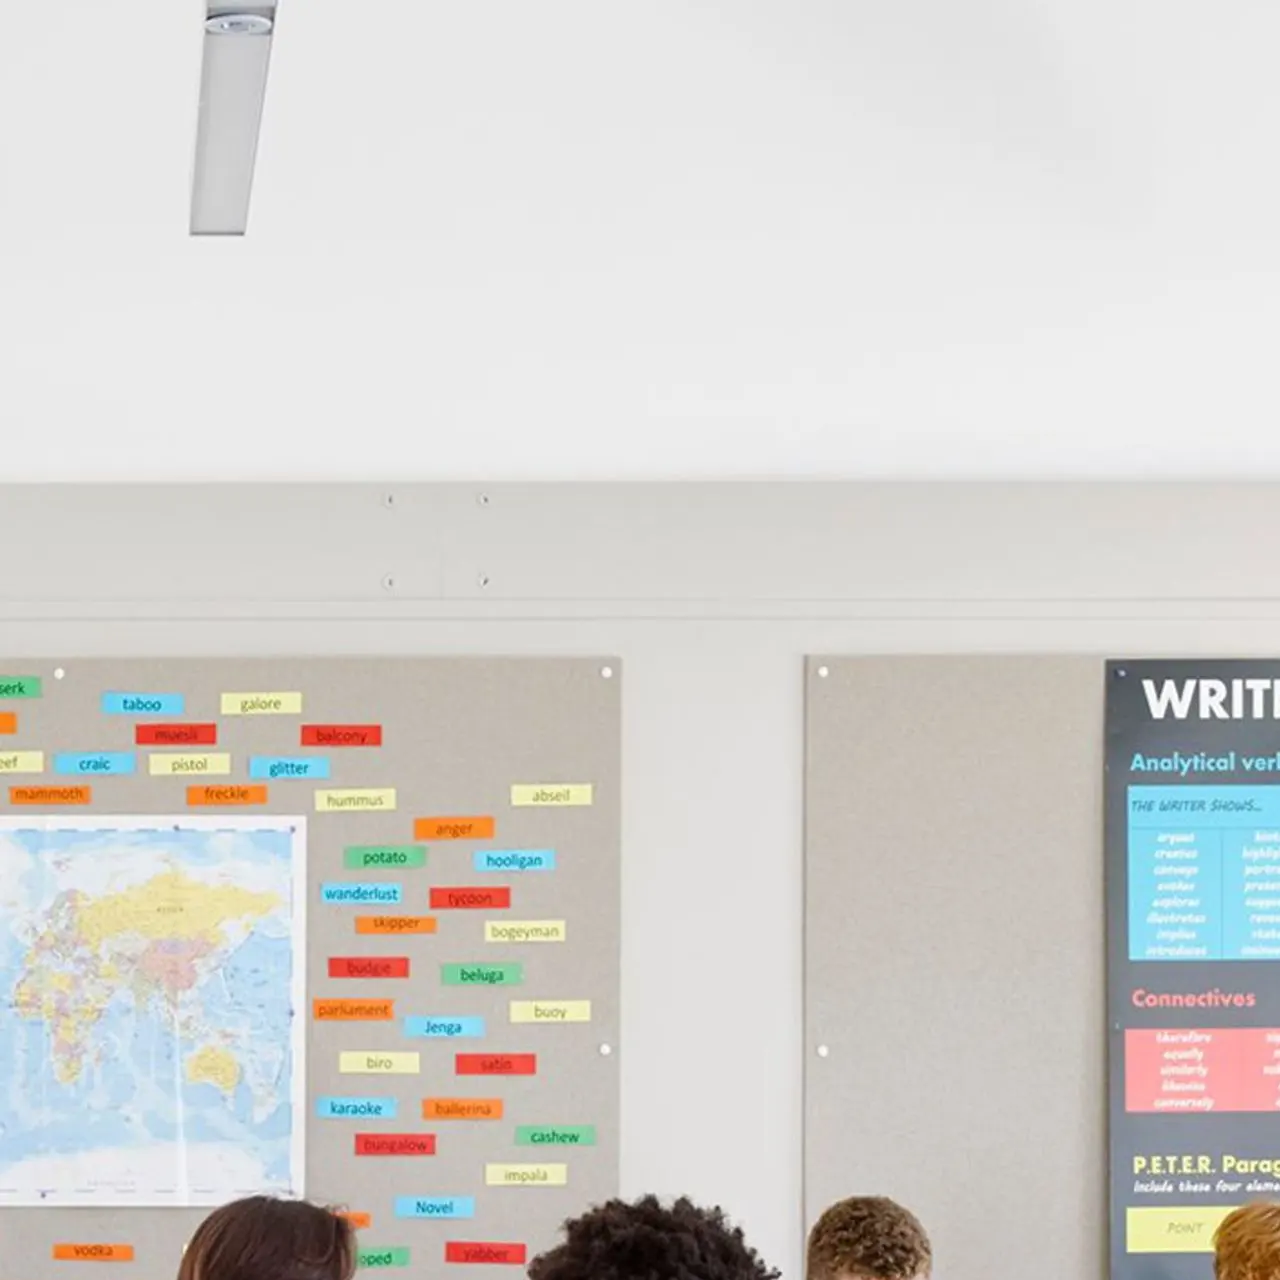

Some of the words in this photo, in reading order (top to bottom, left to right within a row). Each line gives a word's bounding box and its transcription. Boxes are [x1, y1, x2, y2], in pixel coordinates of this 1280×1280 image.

[122, 696, 162, 712] taboo
[240, 696, 281, 713] galore
[316, 728, 368, 745] balcony
[80, 756, 110, 772] craic
[171, 756, 208, 773] pistol
[269, 760, 309, 776] glitter
[1130, 754, 1235, 776] Analytical
[16, 786, 83, 800] mammoth
[205, 786, 248, 800] freckle
[327, 792, 384, 808] hummus
[532, 786, 570, 802] abseil
[1132, 800, 1156, 812] THE
[1159, 800, 1207, 812] WRITER
[436, 821, 473, 837] anger
[363, 849, 407, 867] potato
[486, 852, 543, 870] hooligan
[325, 886, 398, 902] wanderlust
[448, 890, 492, 907] tycoon
[374, 916, 420, 931] skipper
[491, 923, 559, 940] bogeyman
[460, 966, 504, 984] beluga
[1132, 990, 1256, 1008] Connectives
[318, 1002, 390, 1019] parliament
[534, 1004, 567, 1020] buoy
[424, 1019, 462, 1036] Jenga
[366, 1054, 393, 1070] biro
[480, 1055, 512, 1072] satin
[330, 1100, 383, 1117] karaoke
[435, 1101, 493, 1117] ballerina
[531, 1129, 580, 1145] cashew
[364, 1137, 428, 1154] bungalow
[1133, 1156, 1215, 1174] P.E.T.E.R.
[504, 1166, 549, 1184] impala
[1134, 1181, 1173, 1193] Include
[1180, 1181, 1210, 1193] these
[1216, 1180, 1241, 1193] four
[416, 1200, 454, 1215] Novel
[1167, 1222, 1203, 1235] POINT
[74, 1244, 114, 1257] vodka
[360, 1250, 392, 1267] oped
